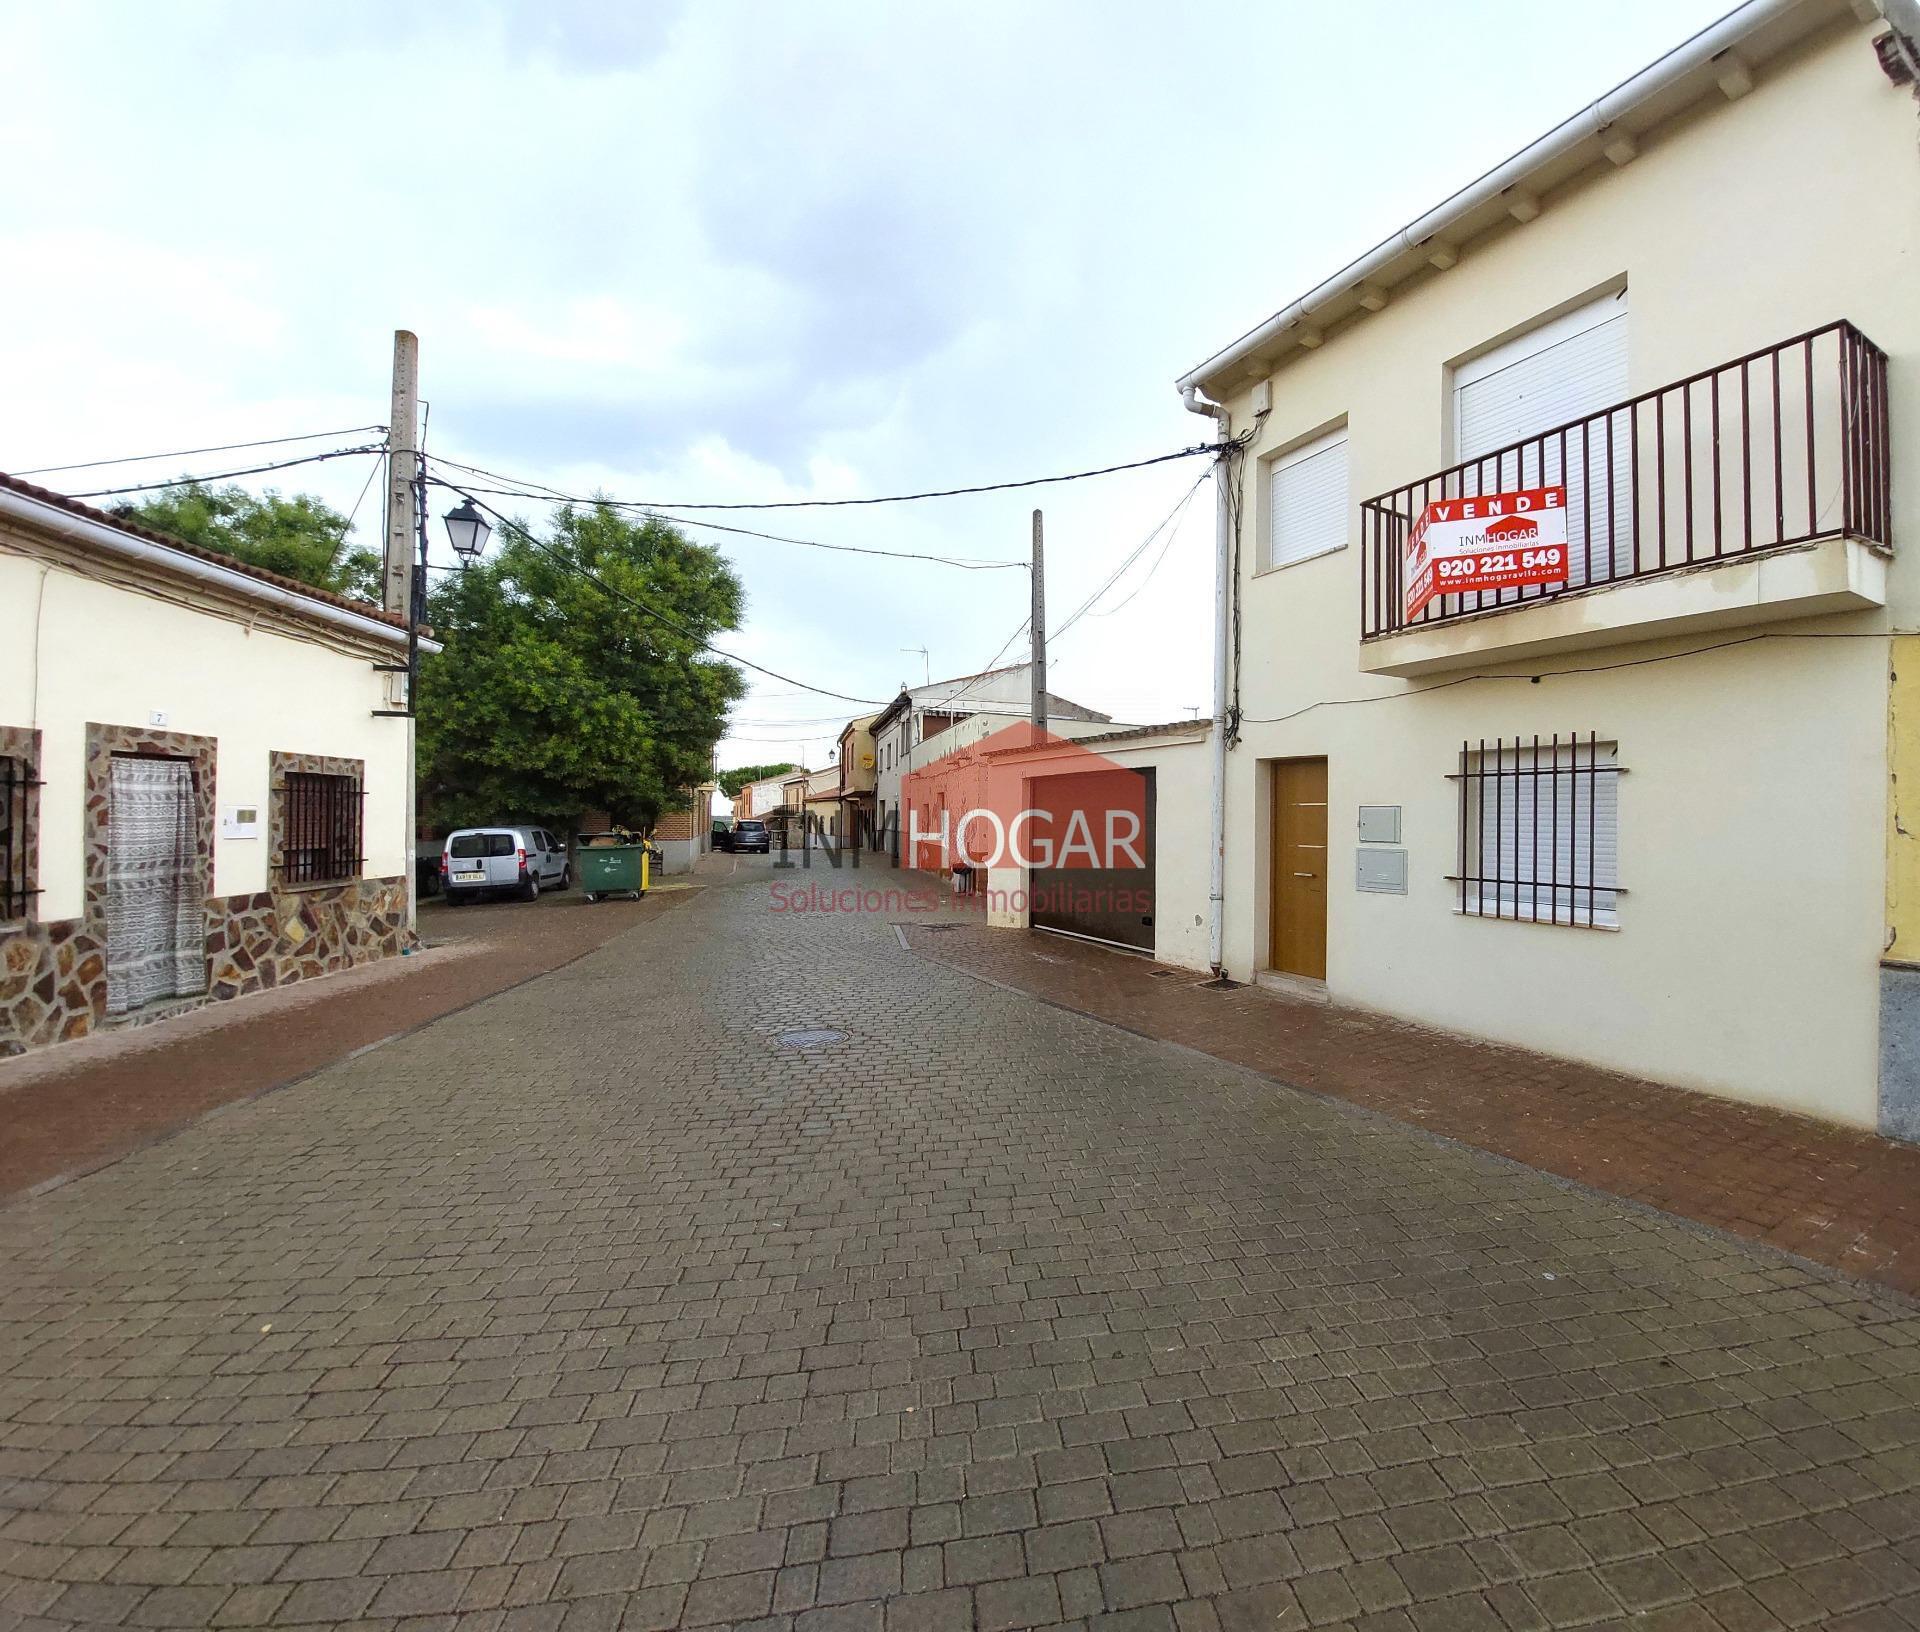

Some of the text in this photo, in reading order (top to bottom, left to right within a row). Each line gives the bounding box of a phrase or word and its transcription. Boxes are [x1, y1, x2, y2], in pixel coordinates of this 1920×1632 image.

[1436, 492, 1558, 522] VENDE
[1459, 527, 1538, 547] INMHOGAR
[1438, 558, 1476, 578] 920
[1480, 554, 1518, 573] 221
[1522, 548, 1561, 568] 549
[1439, 566, 1562, 587] www.inmhogaravila.com
